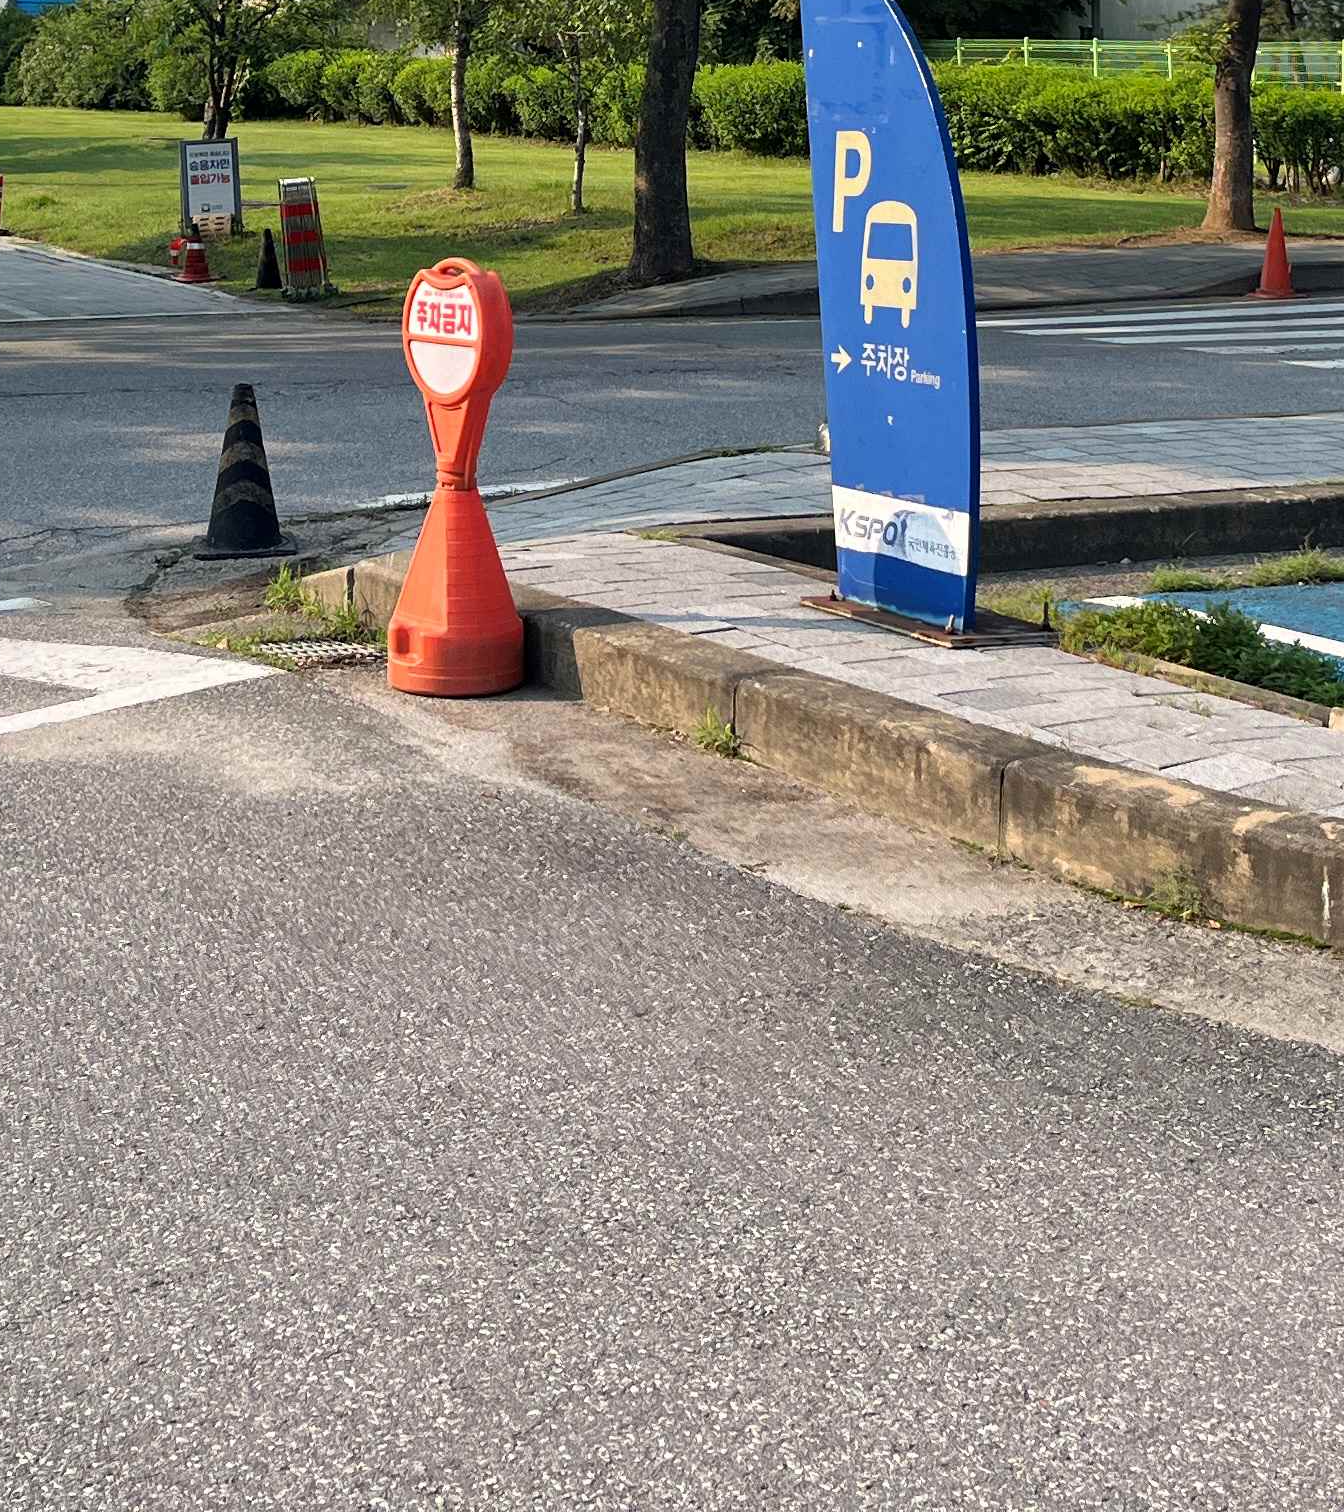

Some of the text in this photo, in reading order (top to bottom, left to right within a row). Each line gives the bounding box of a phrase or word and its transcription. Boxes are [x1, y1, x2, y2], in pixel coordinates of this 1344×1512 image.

[832, 130, 872, 232] P
[417, 301, 472, 335] 주차금지
[860, 343, 940, 389] 주차장 Parking
